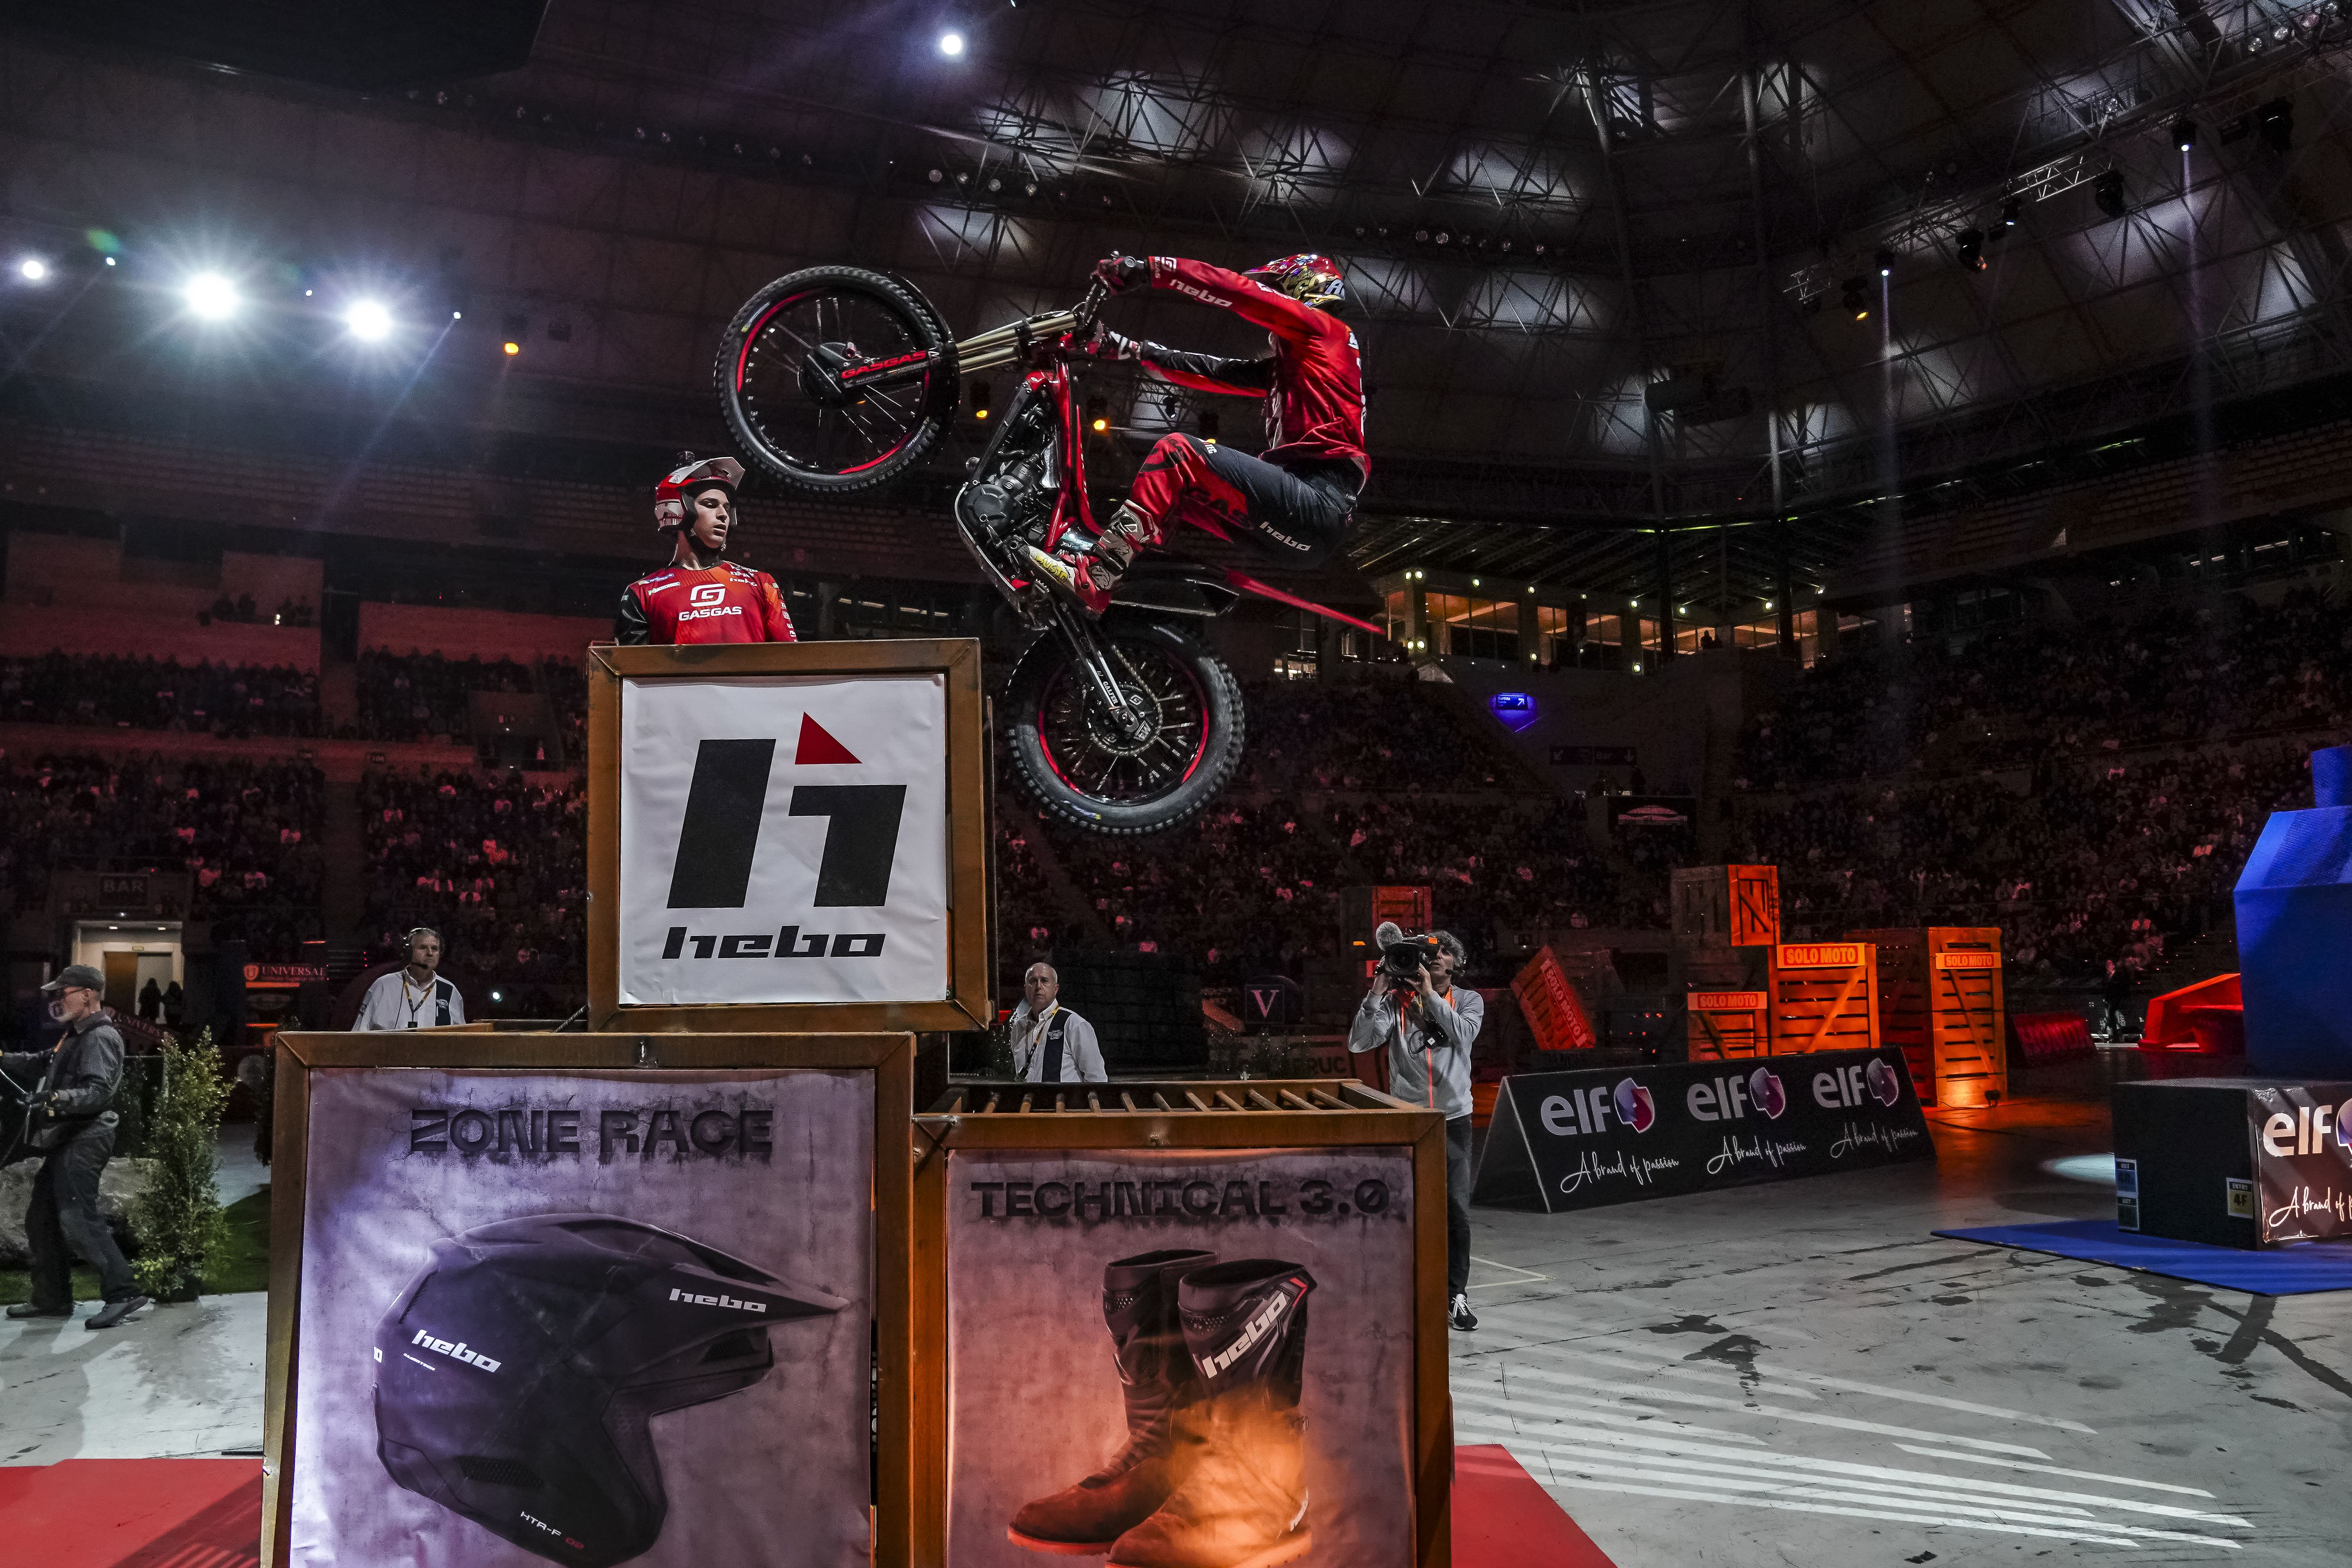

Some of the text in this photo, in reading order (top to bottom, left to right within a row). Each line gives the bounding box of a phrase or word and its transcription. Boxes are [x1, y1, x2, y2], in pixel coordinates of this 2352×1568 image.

[1169, 279, 1232, 307] hebo
[841, 350, 926, 379] GASGAS
[1259, 521, 1311, 551] hebo
[678, 606, 742, 621] GASGAS
[103, 879, 144, 893] BAR
[661, 925, 886, 959] hebo
[1787, 947, 1856, 964] SOLO MOTO
[1946, 955, 1993, 967] SOLO MOTO
[1546, 969, 1564, 1001] SOLO
[1560, 999, 1581, 1036] MOTO
[1700, 995, 1756, 1007] SOLO MOTO
[1687, 1075, 1747, 1121] elf
[1813, 1066, 1865, 1108] elf
[1541, 1087, 1611, 1136] elf
[411, 1109, 773, 1153] ZONE RACE
[1852, 1122, 1879, 1146] brand
[2263, 1105, 2332, 1157] elf
[1732, 1135, 1763, 1162] brand
[1765, 1140, 1777, 1167] of
[1776, 1142, 1807, 1165] passion
[1592, 1151, 1627, 1180] brand
[1630, 1155, 1643, 1186] of
[1642, 1157, 1679, 1183] passion
[971, 1178, 1391, 1218] TECHNICAL 3.0
[2269, 1186, 2300, 1228] A
[2302, 1186, 2331, 1215] brand
[2335, 1192, 2345, 1222] of
[669, 1288, 766, 1312] hebo
[412, 1329, 501, 1373] hebo
[1202, 1291, 1287, 1379] hebo
[520, 1511, 562, 1536] HTR-F
